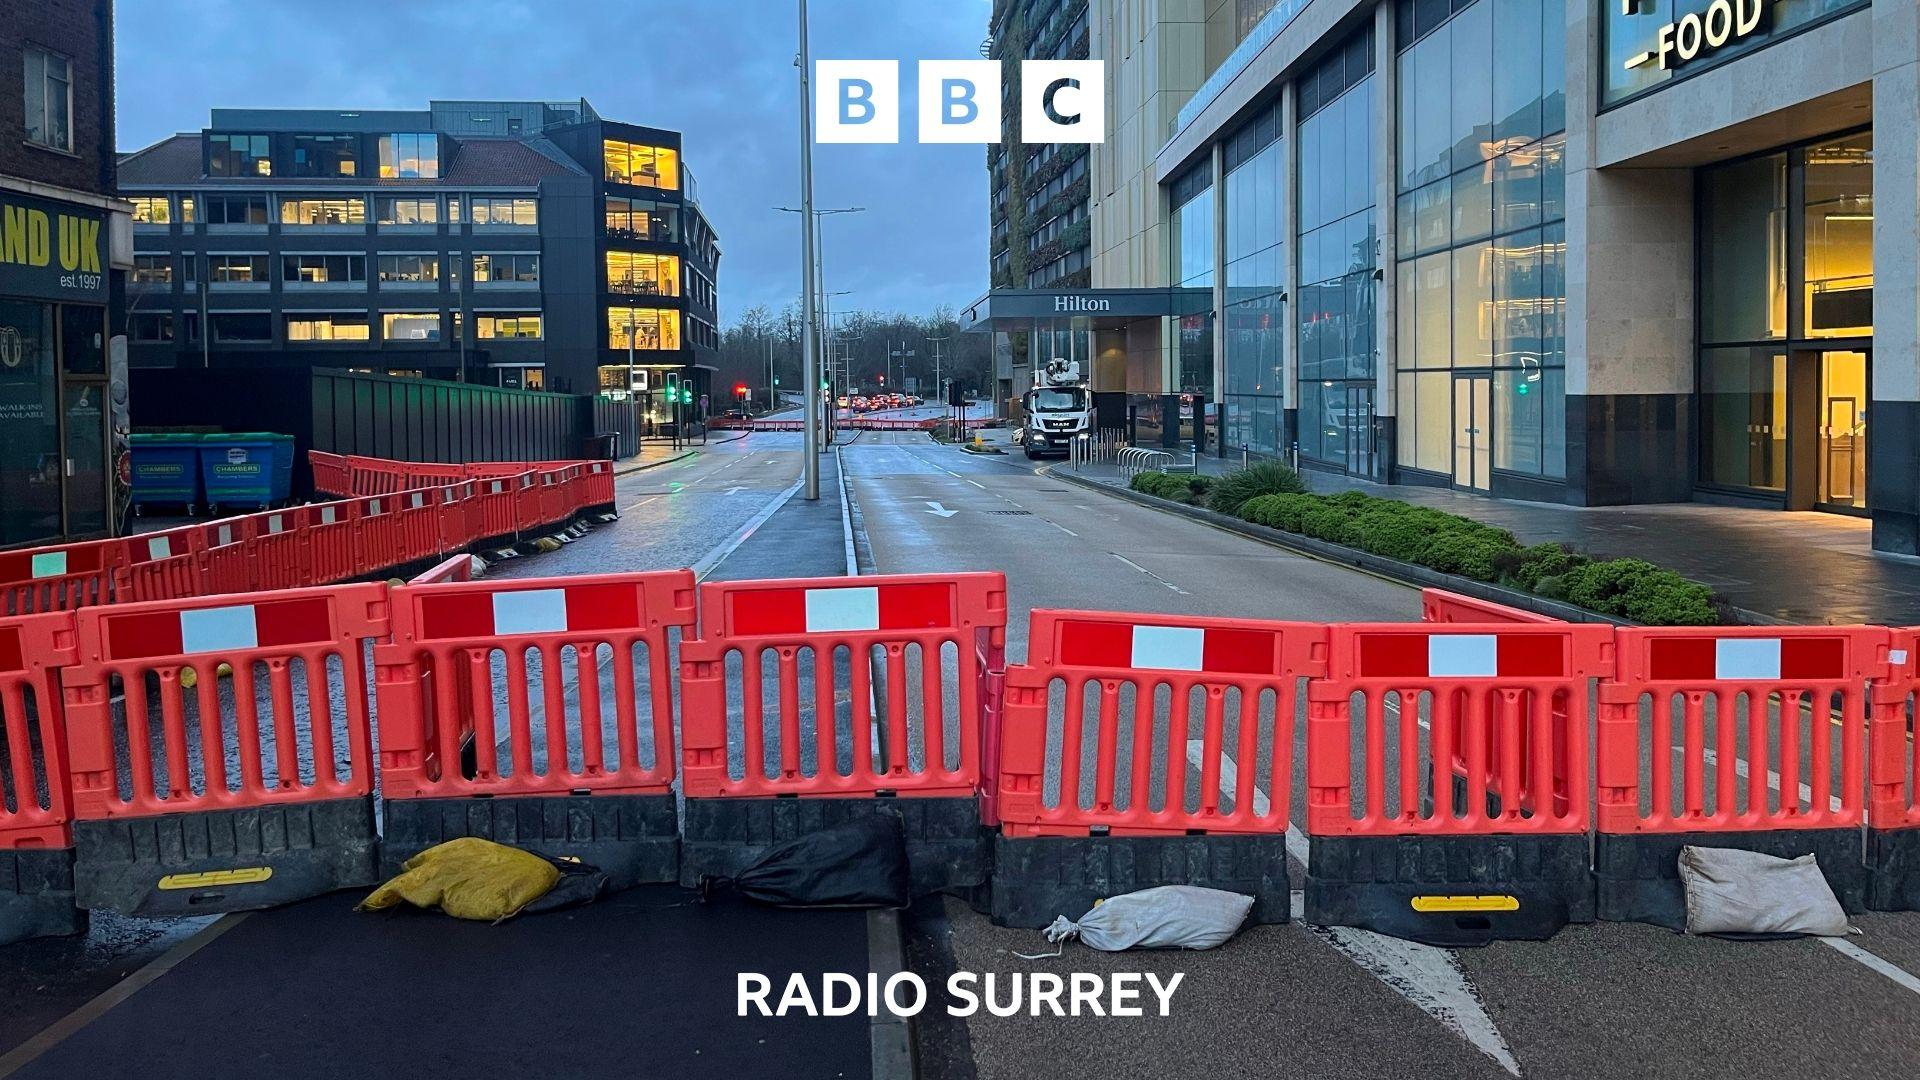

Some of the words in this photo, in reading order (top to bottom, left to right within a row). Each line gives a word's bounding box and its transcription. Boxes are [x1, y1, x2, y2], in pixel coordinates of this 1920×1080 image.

[1658, 0, 1762, 70] FOOD
[0, 204, 50, 267] ND
[58, 214, 101, 273] UK
[1054, 295, 1110, 311] Hilton
